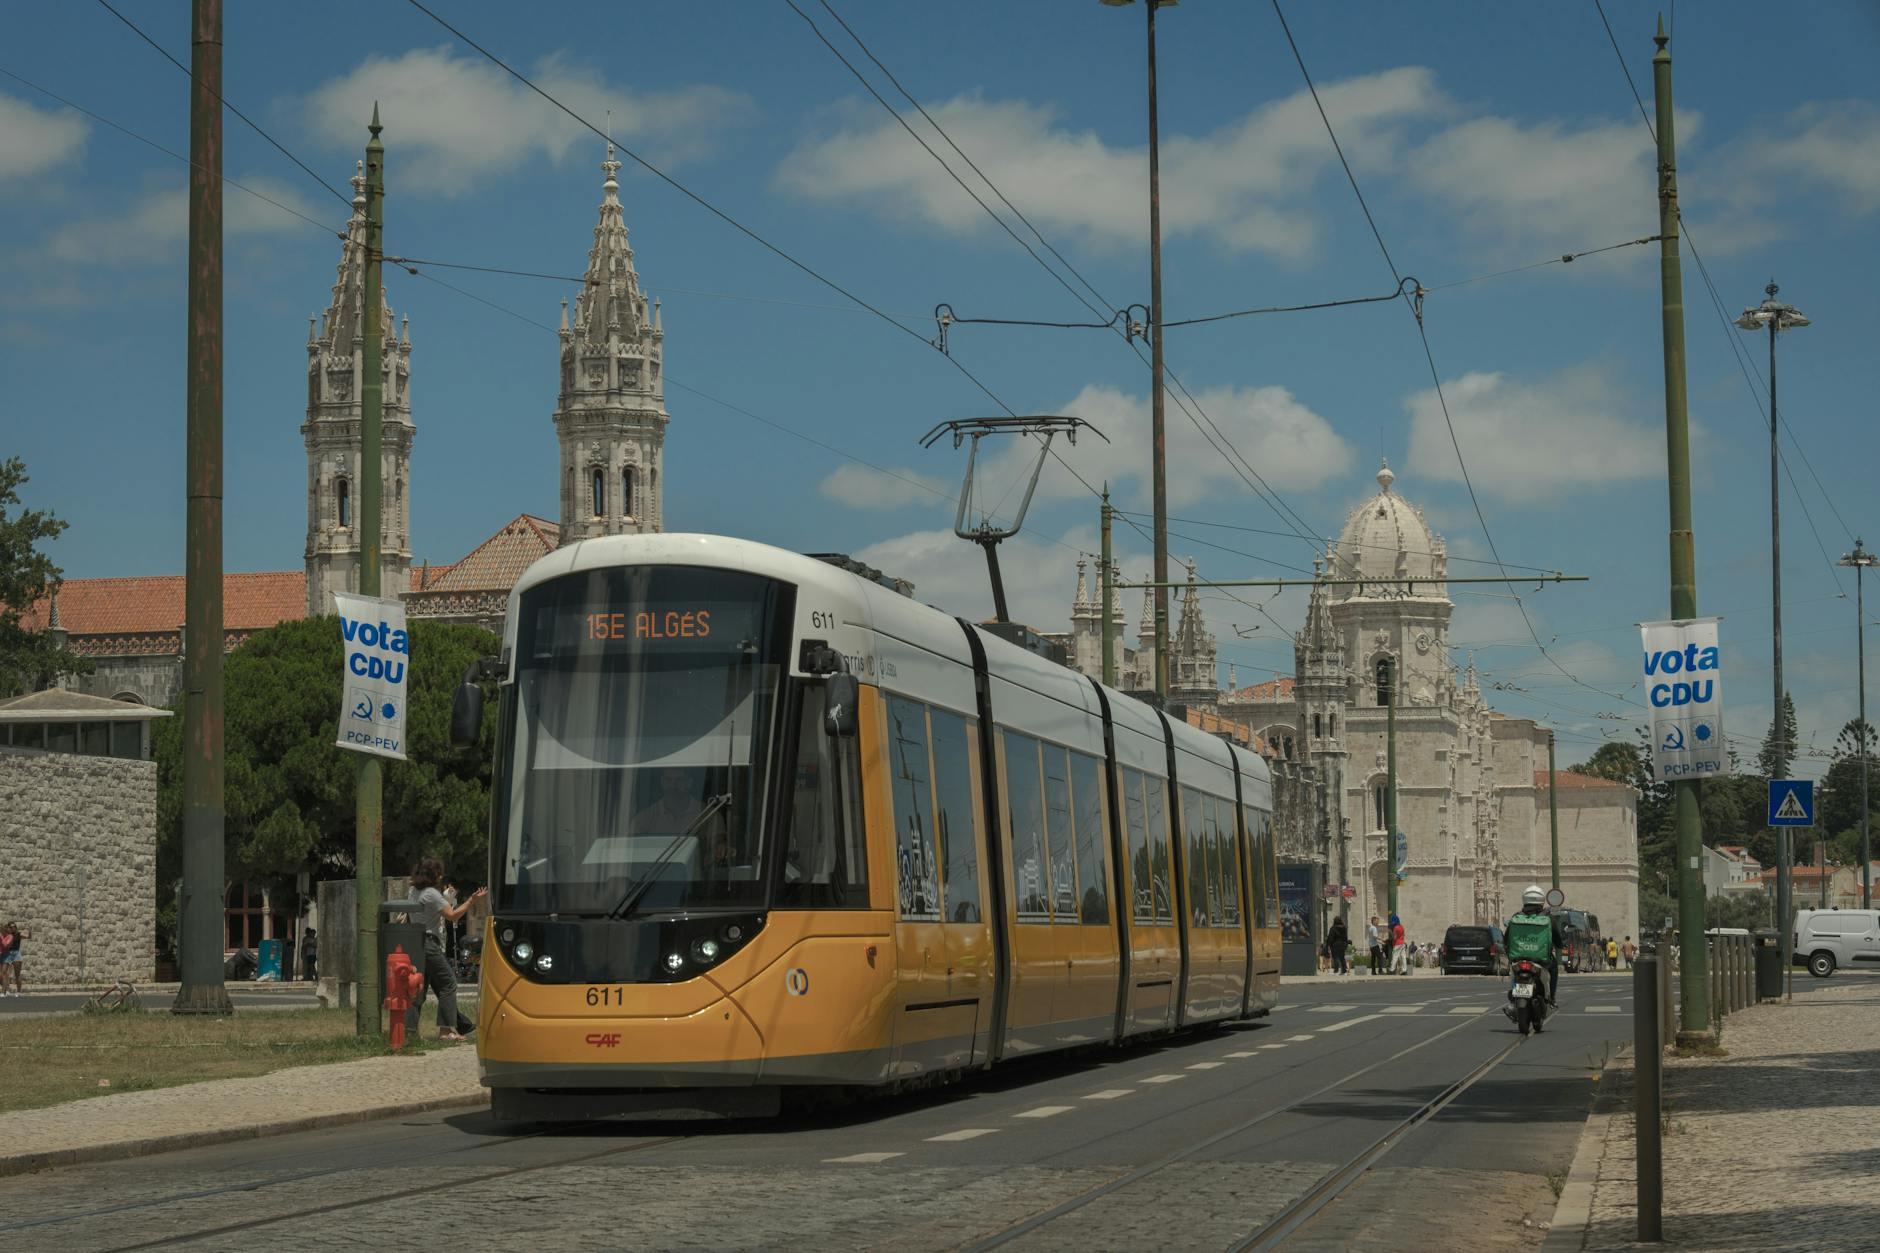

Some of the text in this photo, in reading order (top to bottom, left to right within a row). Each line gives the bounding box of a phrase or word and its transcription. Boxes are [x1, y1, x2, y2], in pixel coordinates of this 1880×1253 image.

[586, 610, 710, 640] 15E ALGÉS
[812, 611, 835, 629] 611
[340, 616, 409, 655] vota
[350, 652, 404, 684] CDU
[1644, 643, 1719, 676] vota
[1650, 679, 1713, 708] CDU
[347, 731, 399, 751] PCP-PEV
[1663, 761, 1721, 776] PCP-PEV
[585, 986, 624, 1007] 611
[585, 1033, 622, 1048] CAF
